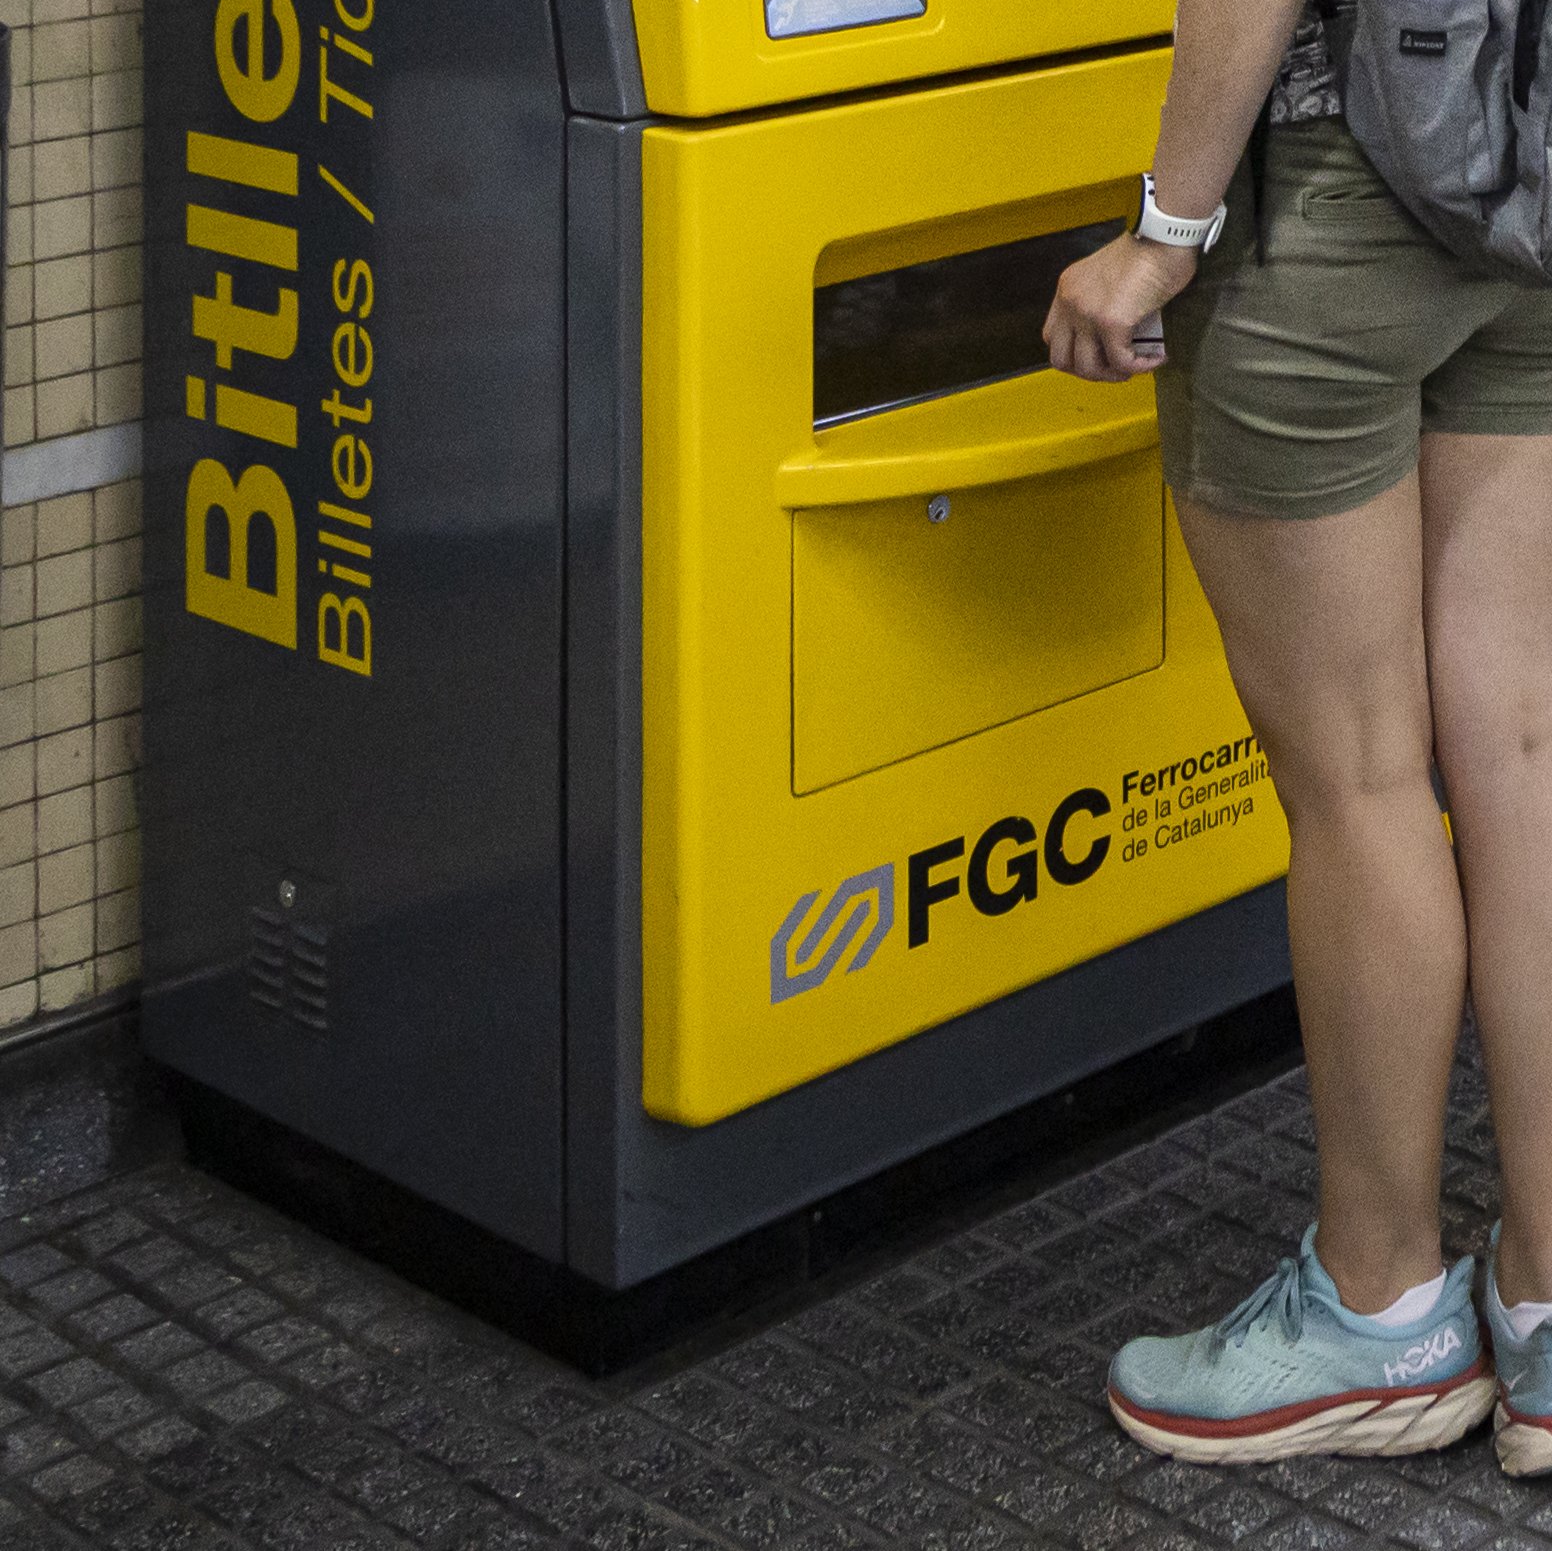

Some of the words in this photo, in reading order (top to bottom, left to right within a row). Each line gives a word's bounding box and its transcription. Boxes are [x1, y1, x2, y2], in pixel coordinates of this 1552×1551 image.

[317, 161, 376, 226] /
[317, 256, 374, 677] Billetes
[1122, 807, 1148, 832] de
[1155, 798, 1171, 820] la
[1178, 759, 1271, 810] Generalit
[1122, 838, 1148, 863] de
[1154, 796, 1254, 849] Catalunya
[908, 787, 1113, 950] FGC
[1383, 1325, 1461, 1387] HOKA
